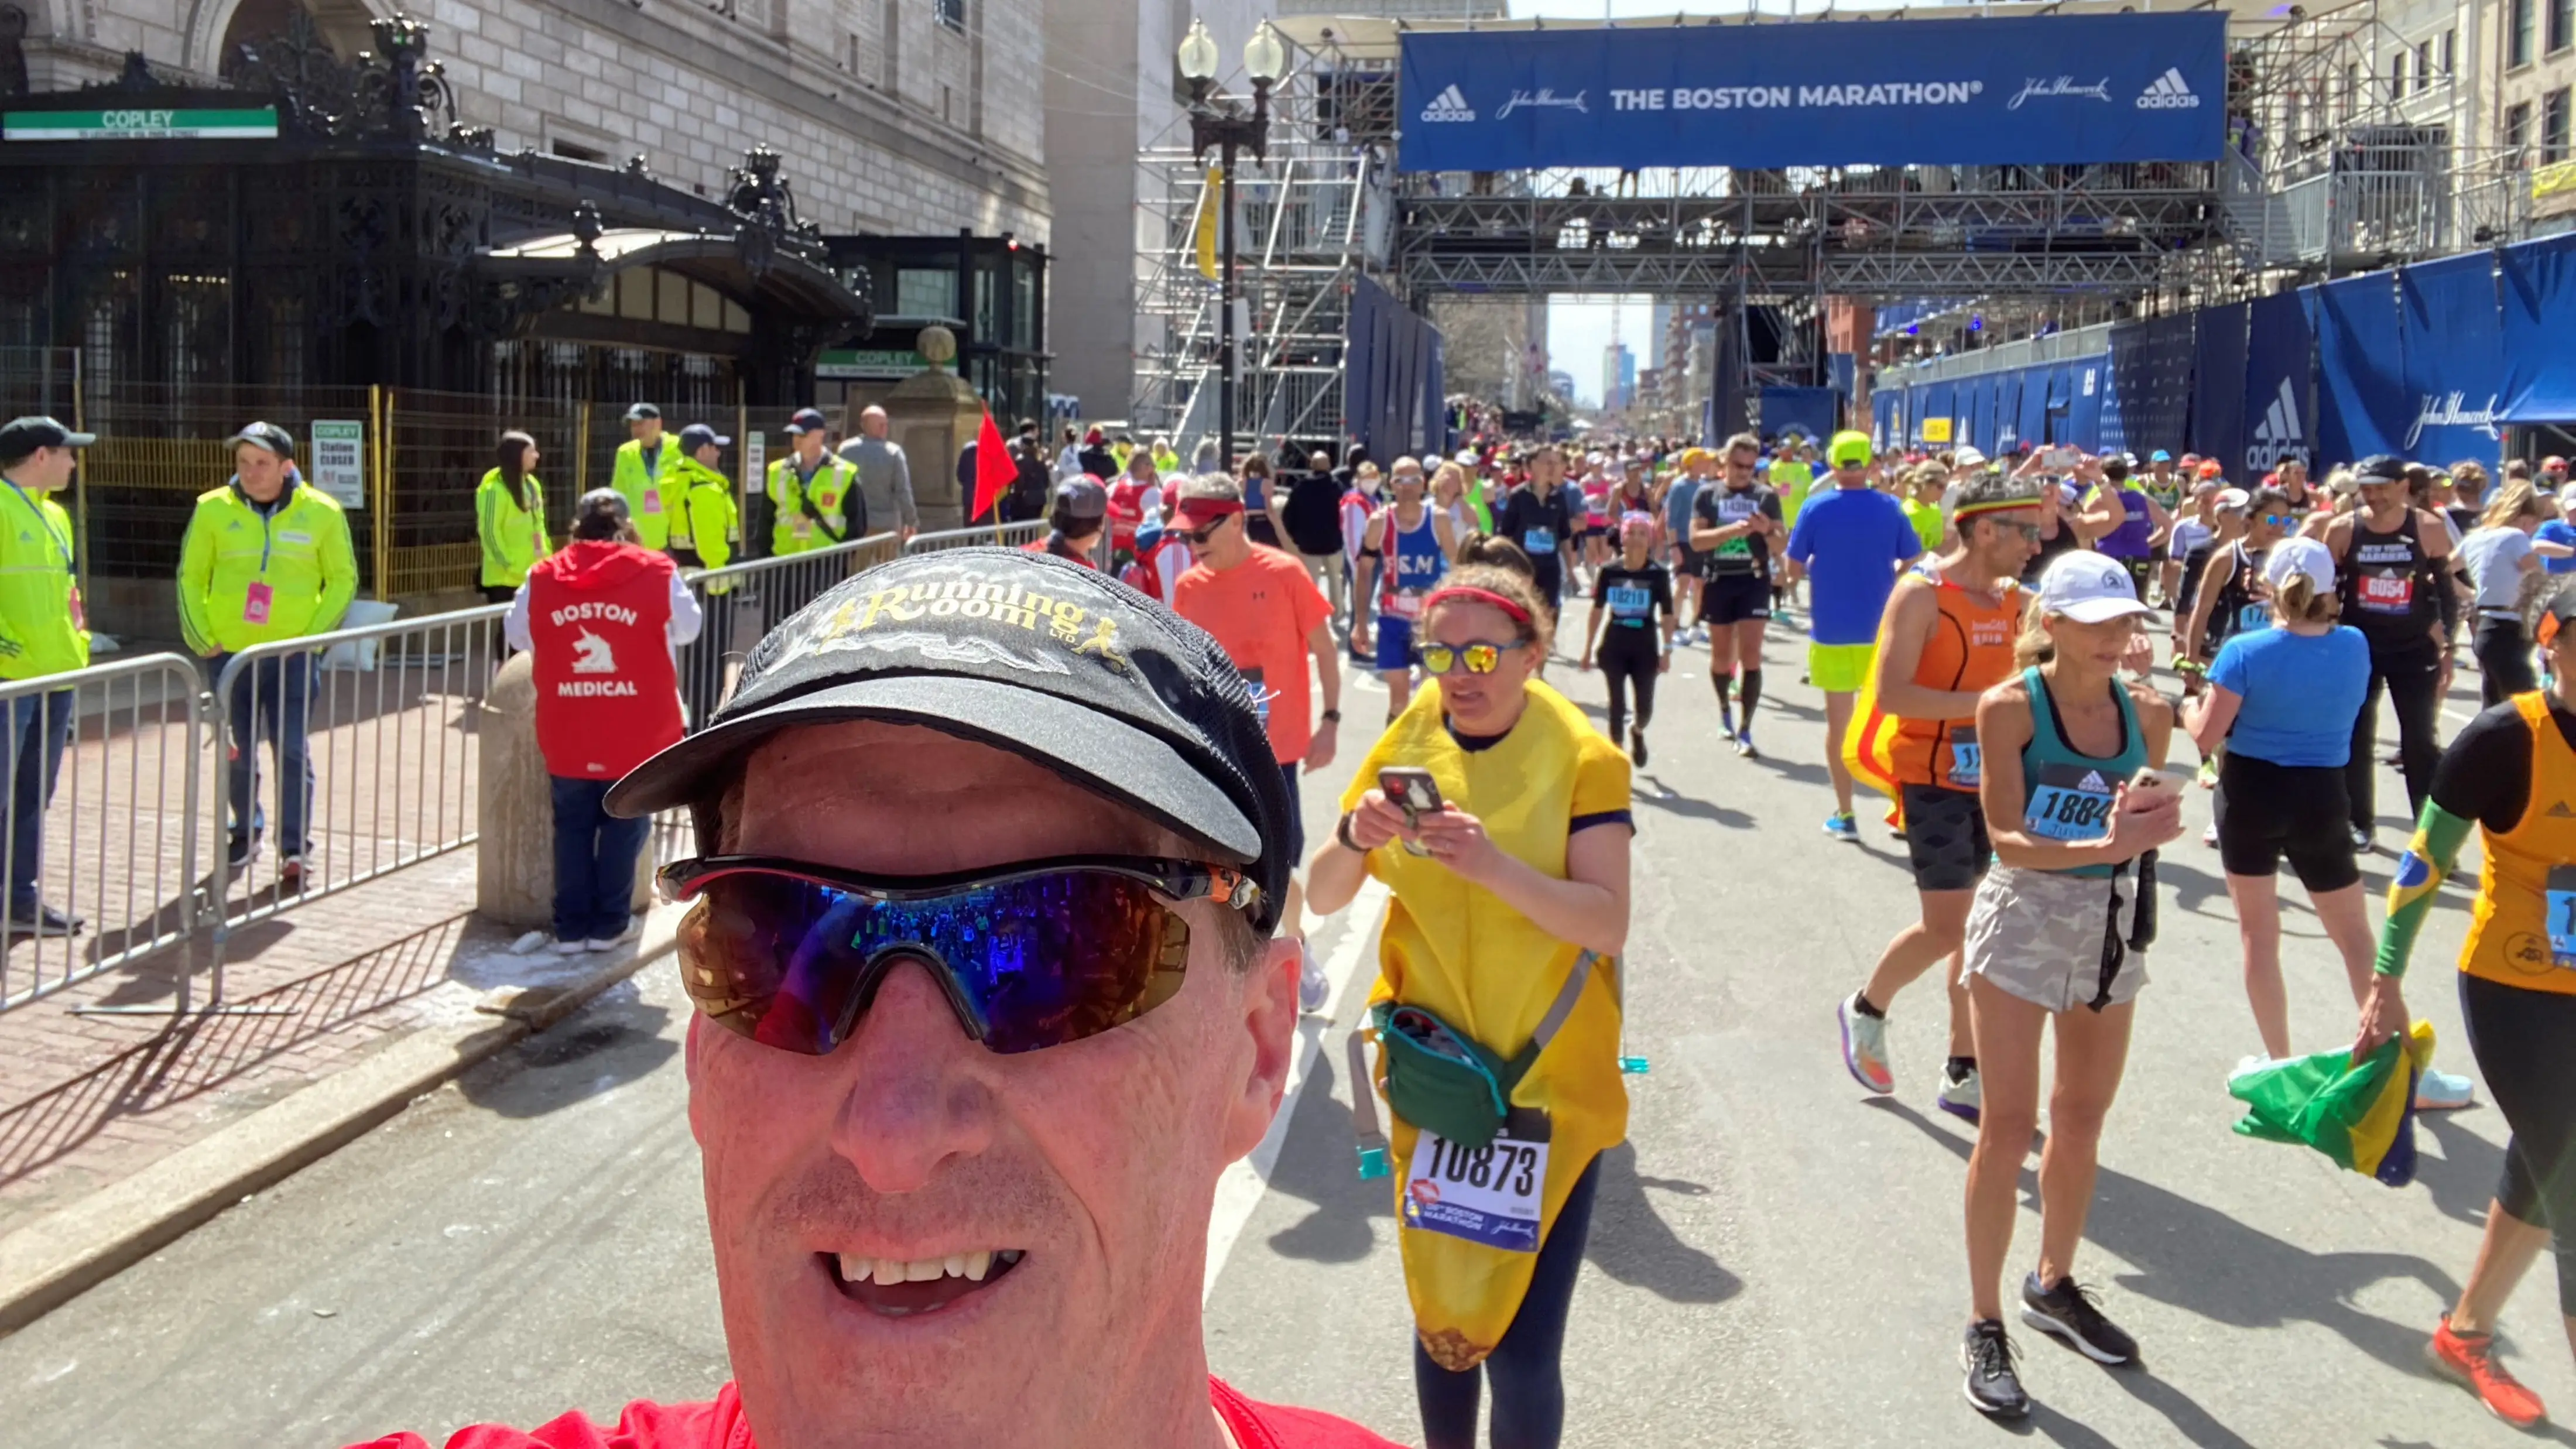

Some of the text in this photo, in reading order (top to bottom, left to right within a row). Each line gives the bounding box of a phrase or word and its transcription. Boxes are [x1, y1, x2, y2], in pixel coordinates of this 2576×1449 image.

[1610, 90, 1664, 110] THE
[1673, 87, 1790, 109] BOSTON
[2137, 95, 2200, 108] adidas
[101, 110, 173, 128] COPLEY
[1421, 109, 1475, 122] adidas
[855, 351, 914, 365] COPLEY
[2246, 439, 2309, 471] adidas
[2368, 578, 2406, 599] 6054
[550, 602, 638, 627] BOSTON
[857, 581, 1085, 635] Running
[1049, 628, 1076, 643] LTD
[558, 681, 638, 697] MEDICAL
[1429, 1137, 1537, 1197] 10873
